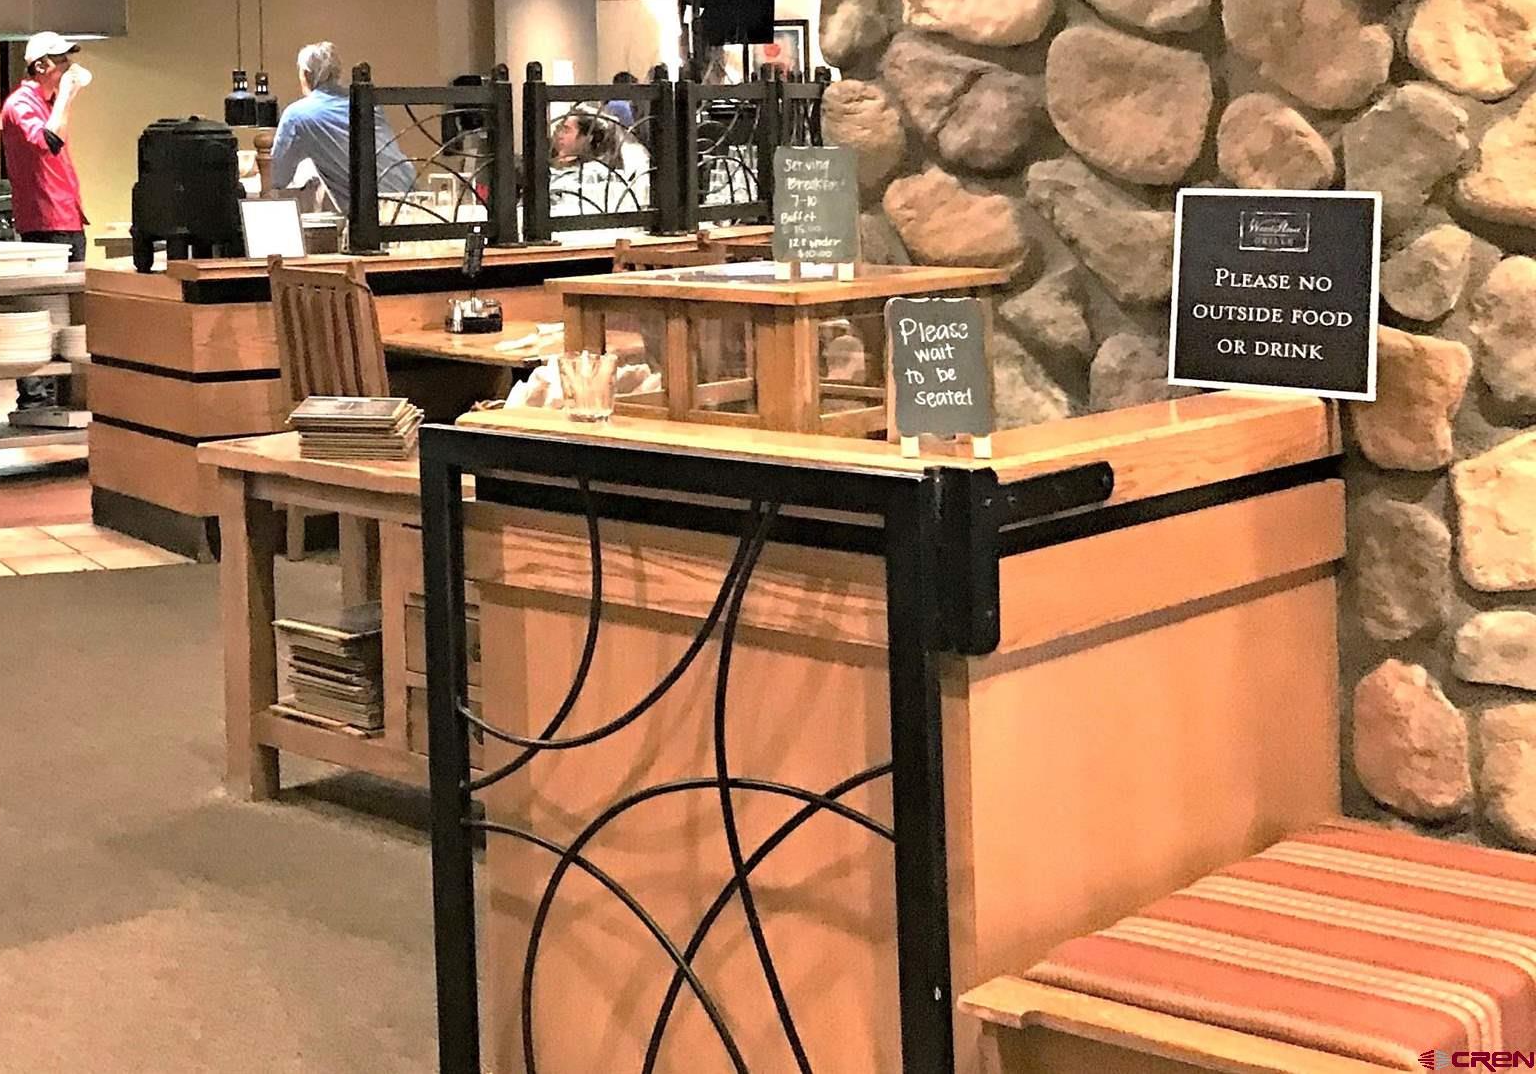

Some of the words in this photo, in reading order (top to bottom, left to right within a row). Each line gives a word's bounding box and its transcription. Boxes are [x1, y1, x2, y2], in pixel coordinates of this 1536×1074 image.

[784, 158, 830, 179] Serving
[790, 194, 817, 207] 7-10
[1215, 268, 1290, 290] PLEASE
[1299, 276, 1332, 292] NO
[1192, 304, 1283, 323] OUTSIDE
[1291, 309, 1353, 327] FOOD
[898, 318, 969, 346] Please
[914, 344, 955, 363] wait
[1217, 339, 1247, 354] OR
[1255, 341, 1324, 360] DRINK
[905, 368, 925, 385] to
[937, 366, 957, 383] be
[914, 387, 973, 408] seated
